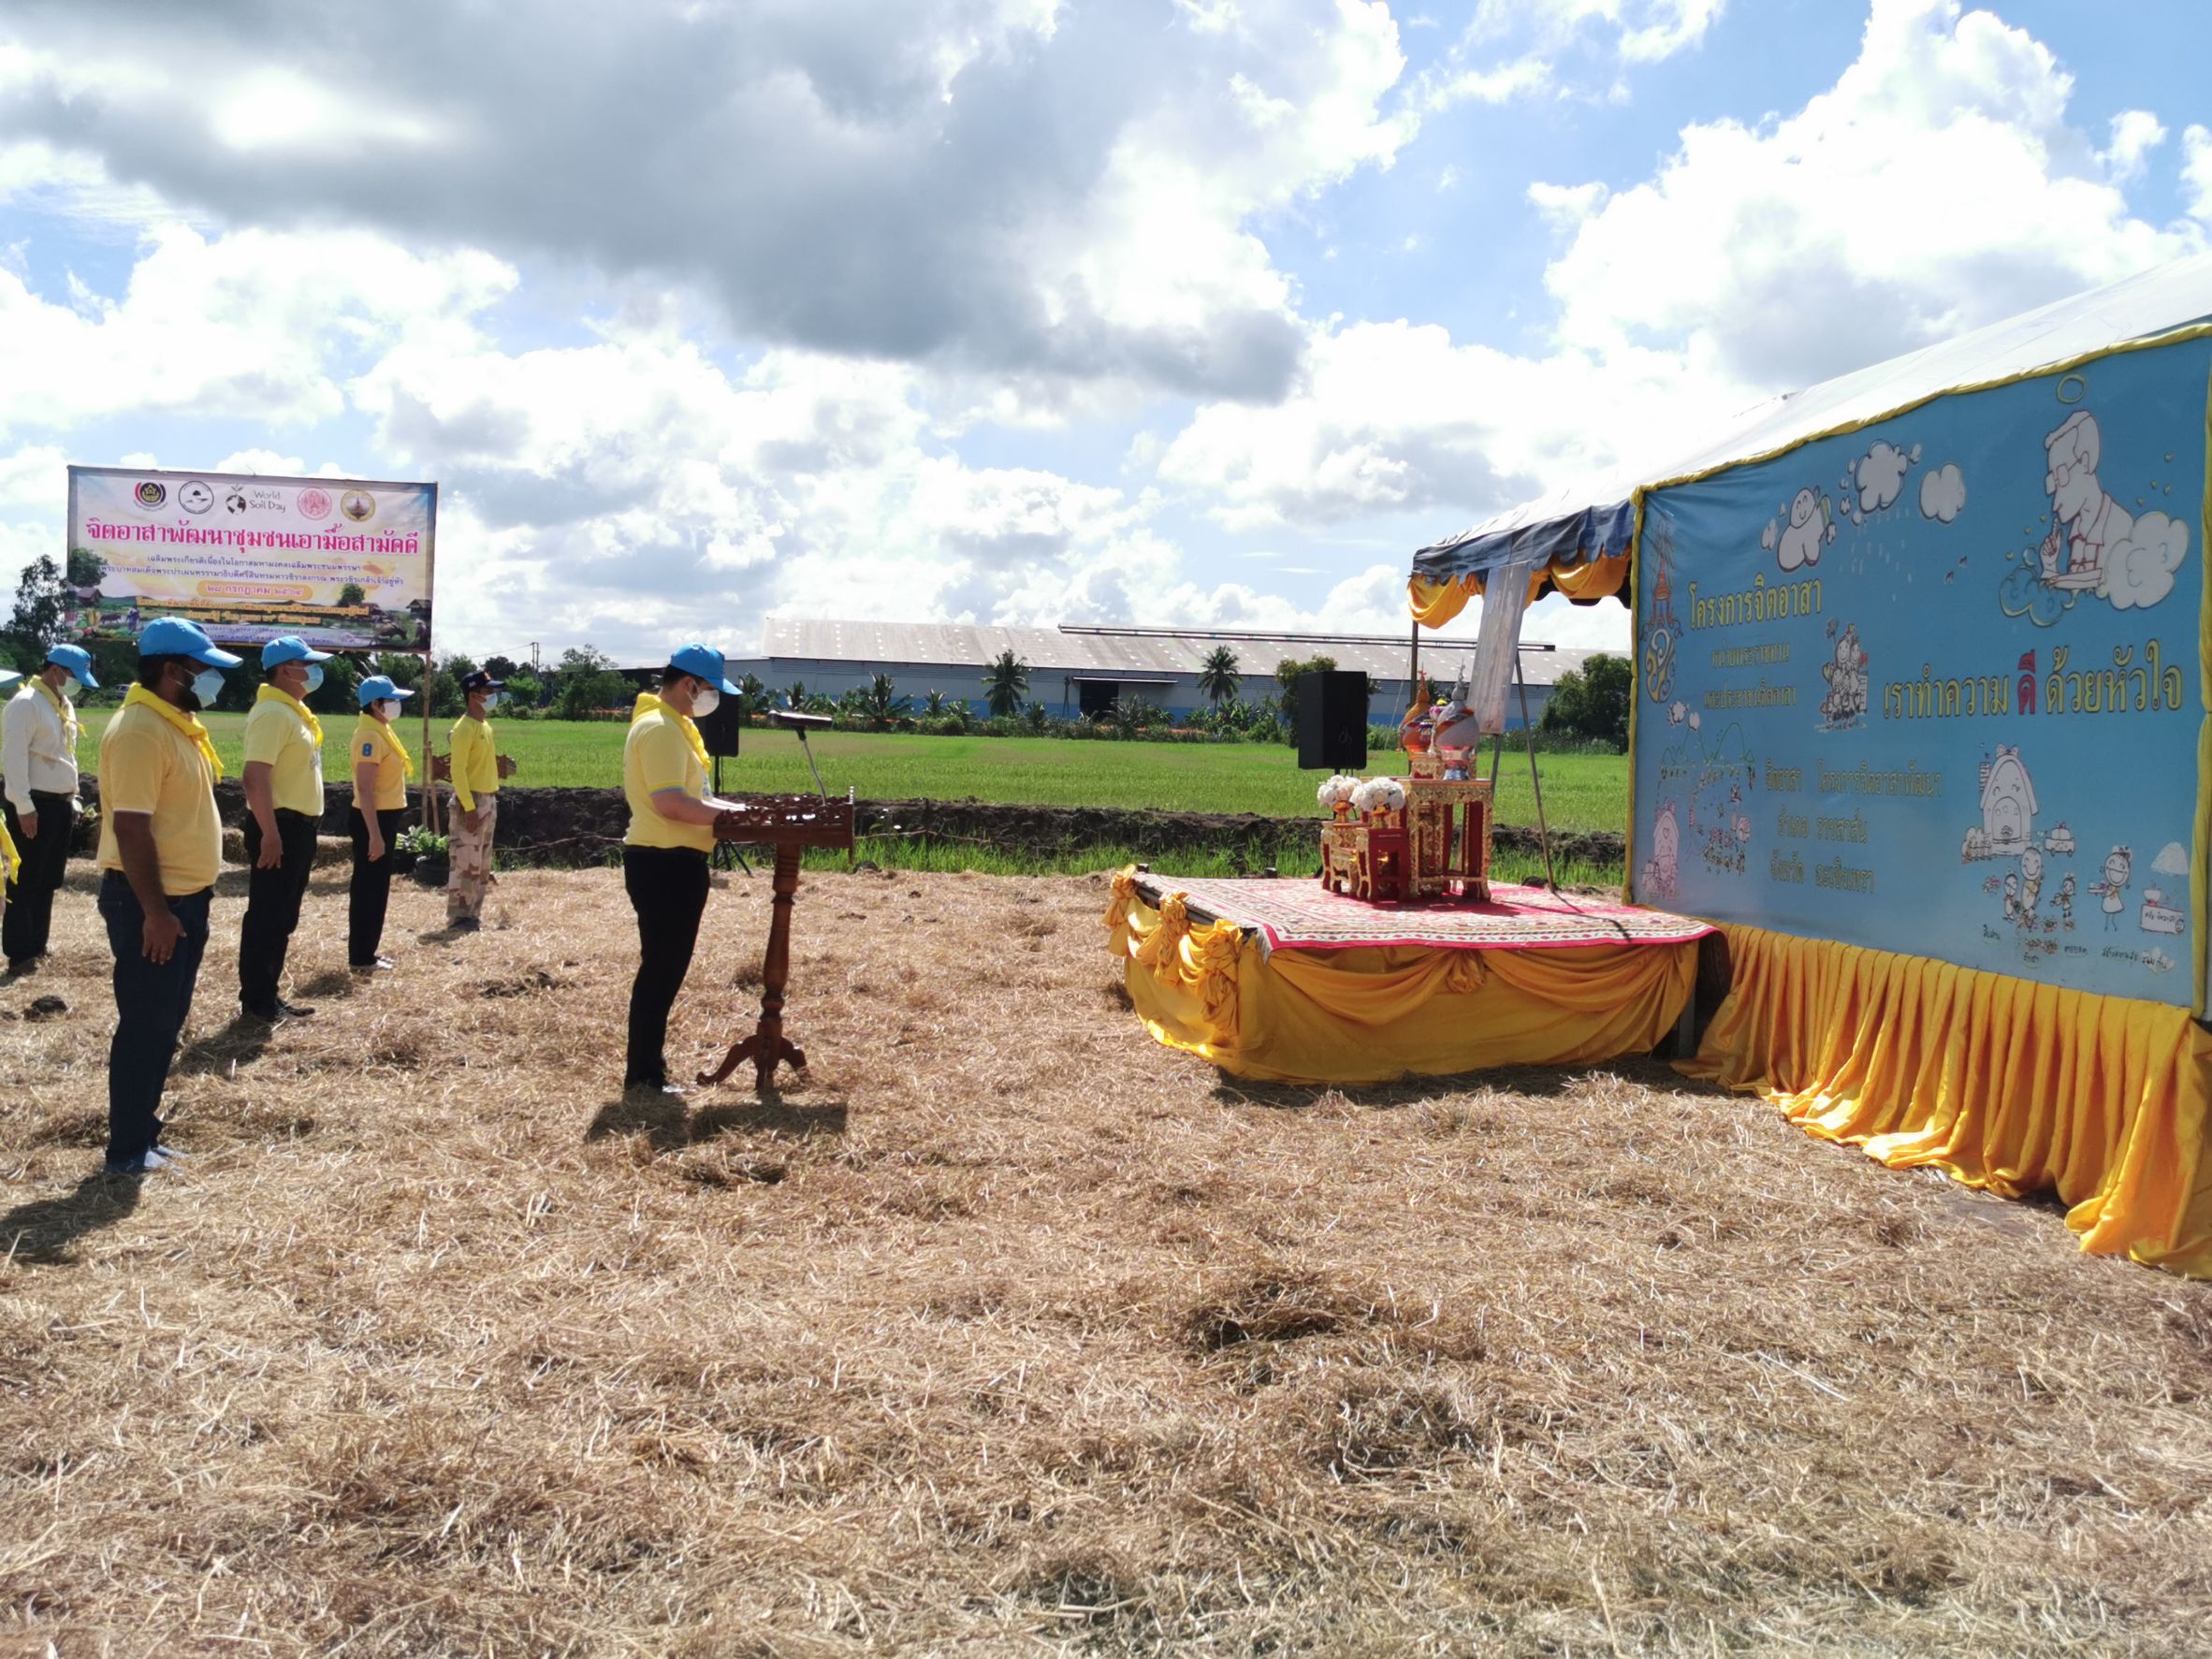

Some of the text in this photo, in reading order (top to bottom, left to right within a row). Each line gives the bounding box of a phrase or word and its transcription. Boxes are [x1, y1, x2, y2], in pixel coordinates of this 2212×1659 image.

[250, 501, 286, 513] Soil Day
[254, 490, 281, 500] World
[86, 517, 418, 554] จิตอาสาพัฒนาชุมชนเอามื้อสามัคคี
[226, 586, 270, 595] กรกฎาคม
[1688, 573, 1823, 630] โครงการจิตอาสา
[1883, 638, 2183, 719] เราทำความ ดี ด้วยหัวใจ
